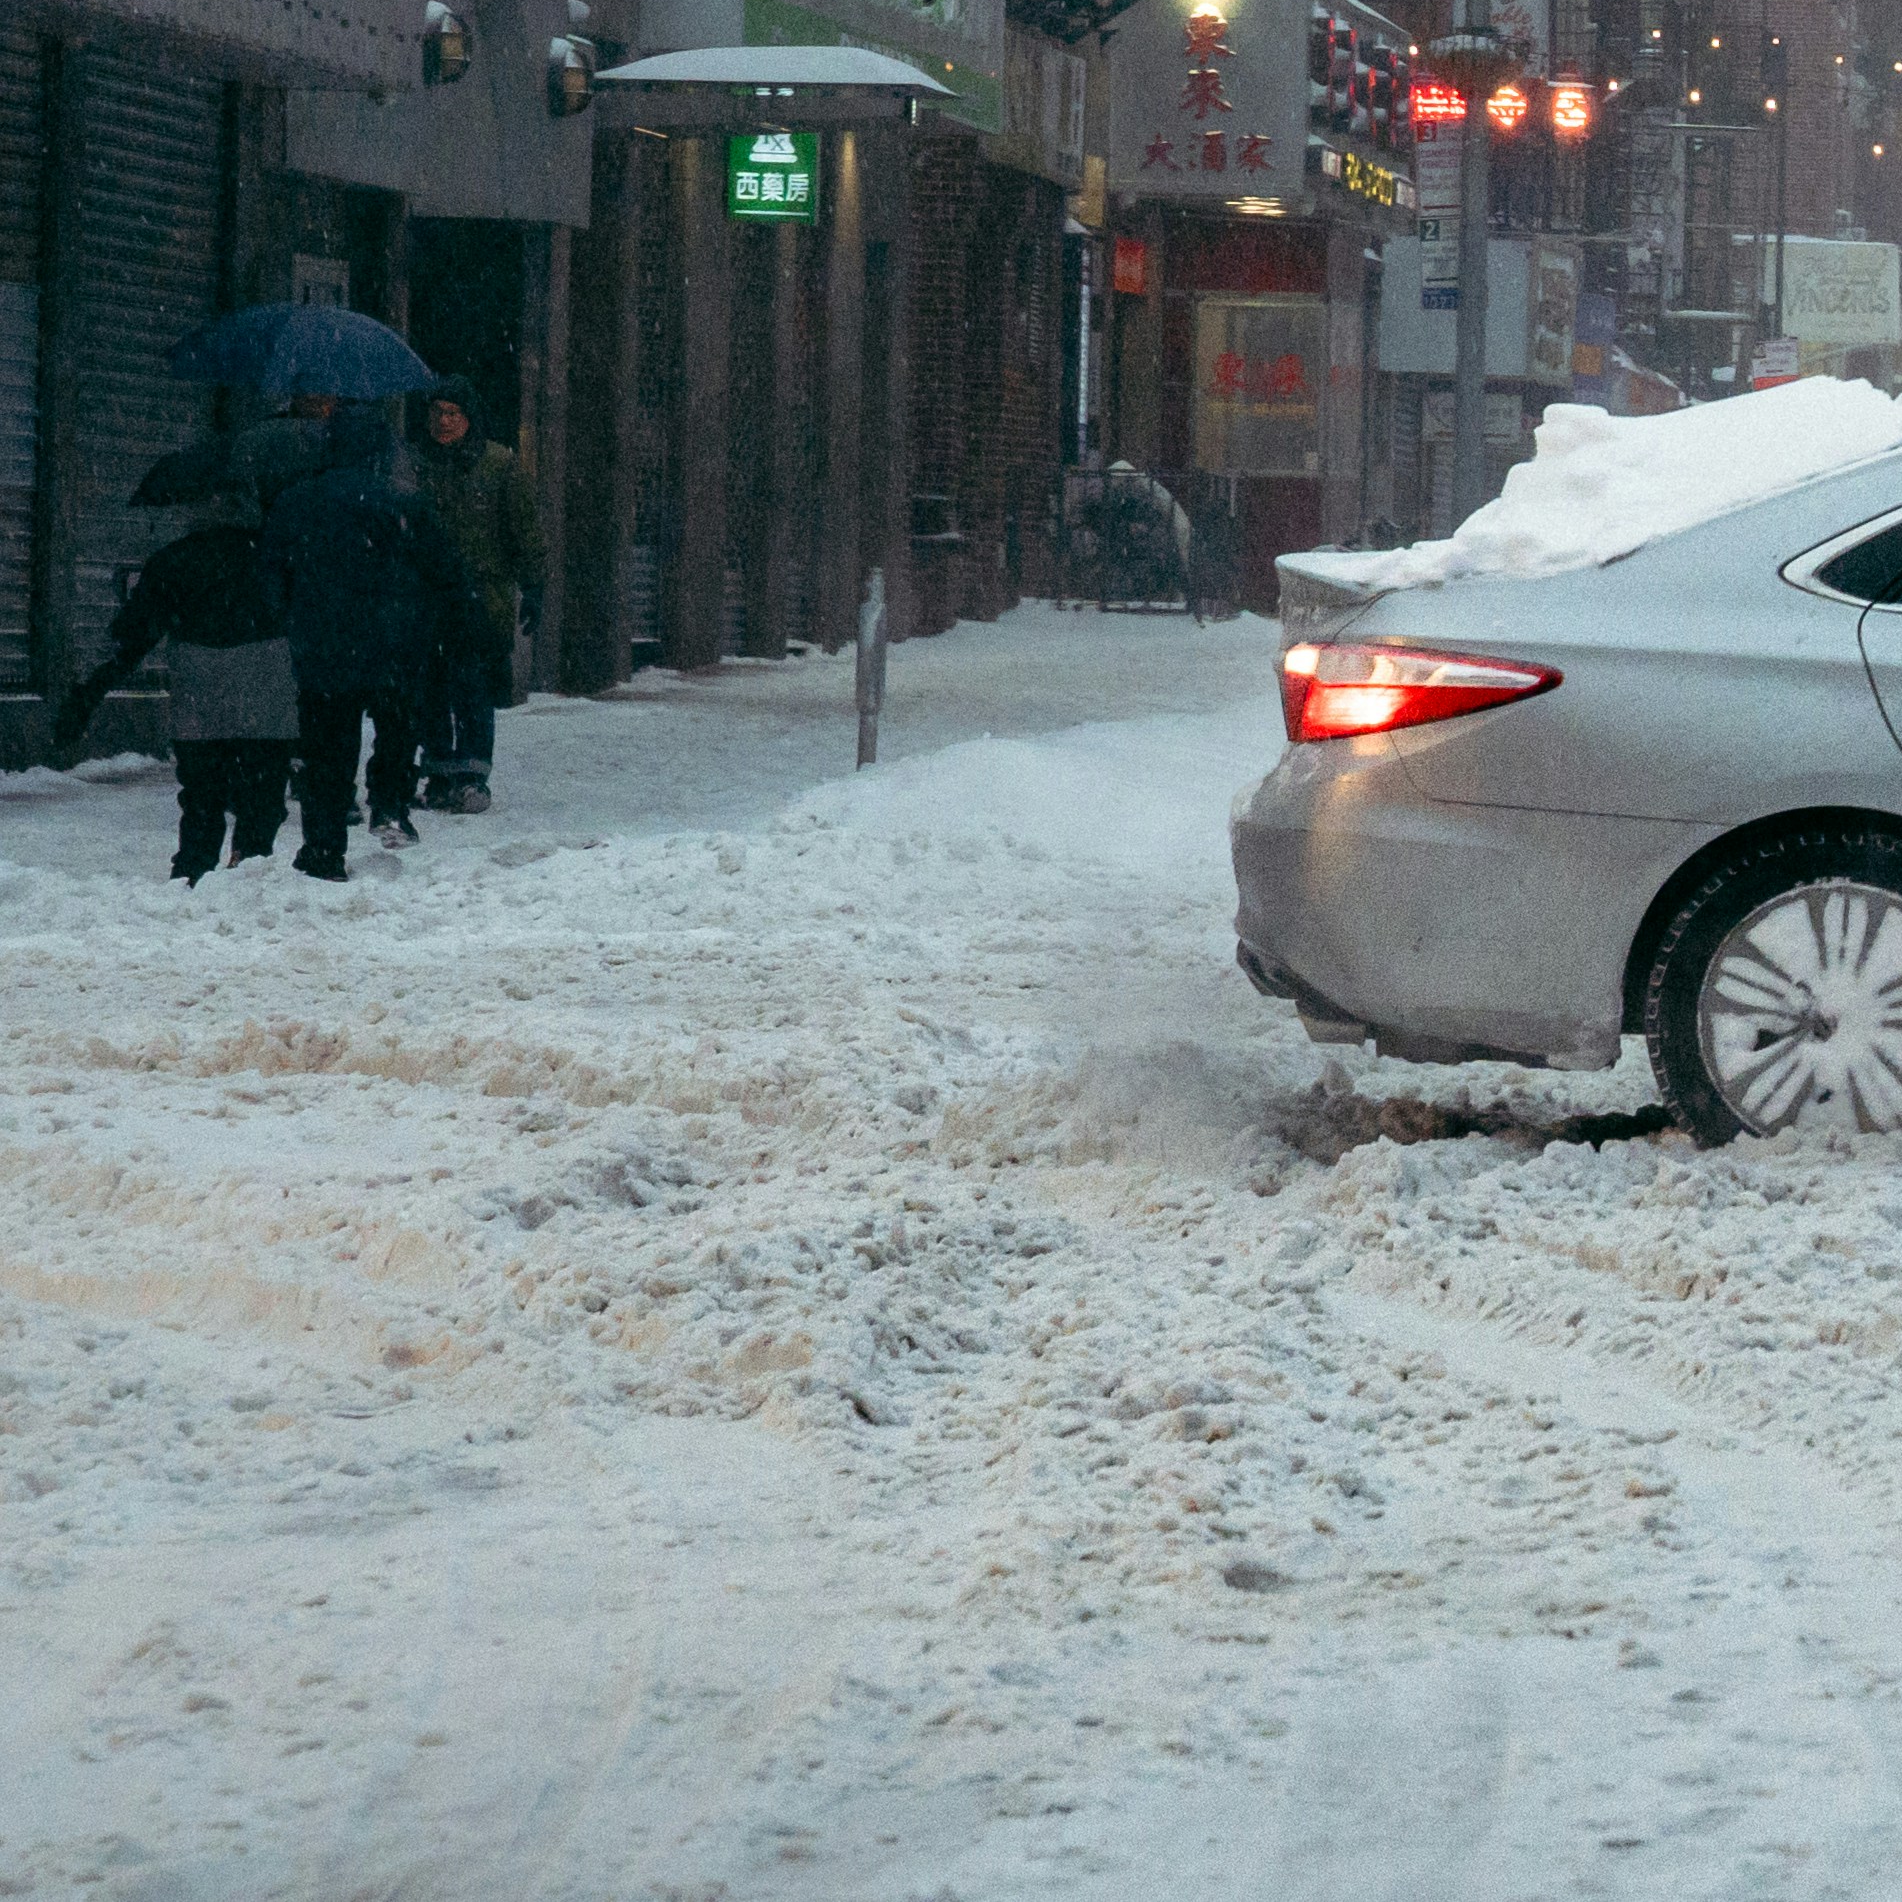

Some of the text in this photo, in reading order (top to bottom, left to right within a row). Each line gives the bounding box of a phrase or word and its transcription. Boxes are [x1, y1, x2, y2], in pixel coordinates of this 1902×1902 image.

[1139, 131, 1273, 174] 大酒家
[736, 172, 809, 202] 西藥房
